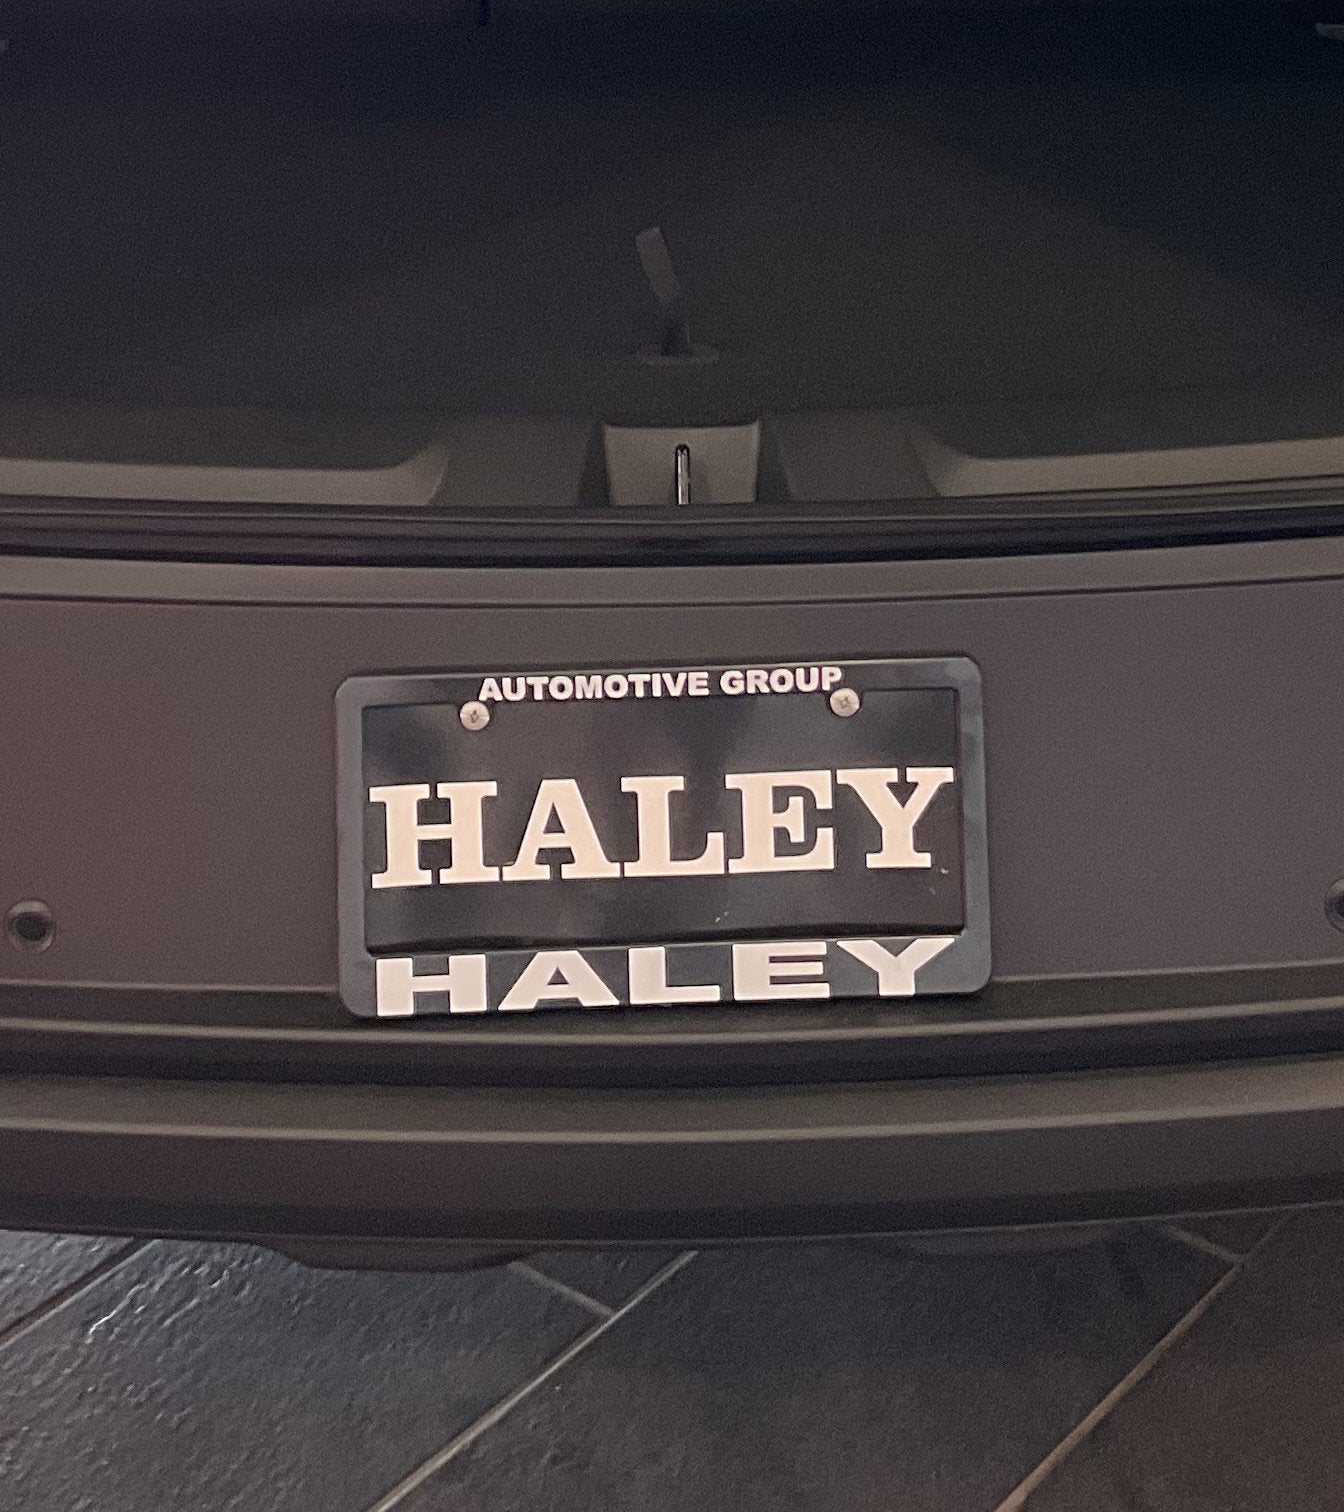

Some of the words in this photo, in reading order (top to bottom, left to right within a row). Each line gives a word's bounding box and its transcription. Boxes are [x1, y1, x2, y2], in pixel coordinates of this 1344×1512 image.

[478, 671, 709, 702] AUTOMOTIVE
[719, 666, 843, 695] GROUP
[368, 766, 954, 889] HALEY
[375, 937, 956, 1017] HALEY
